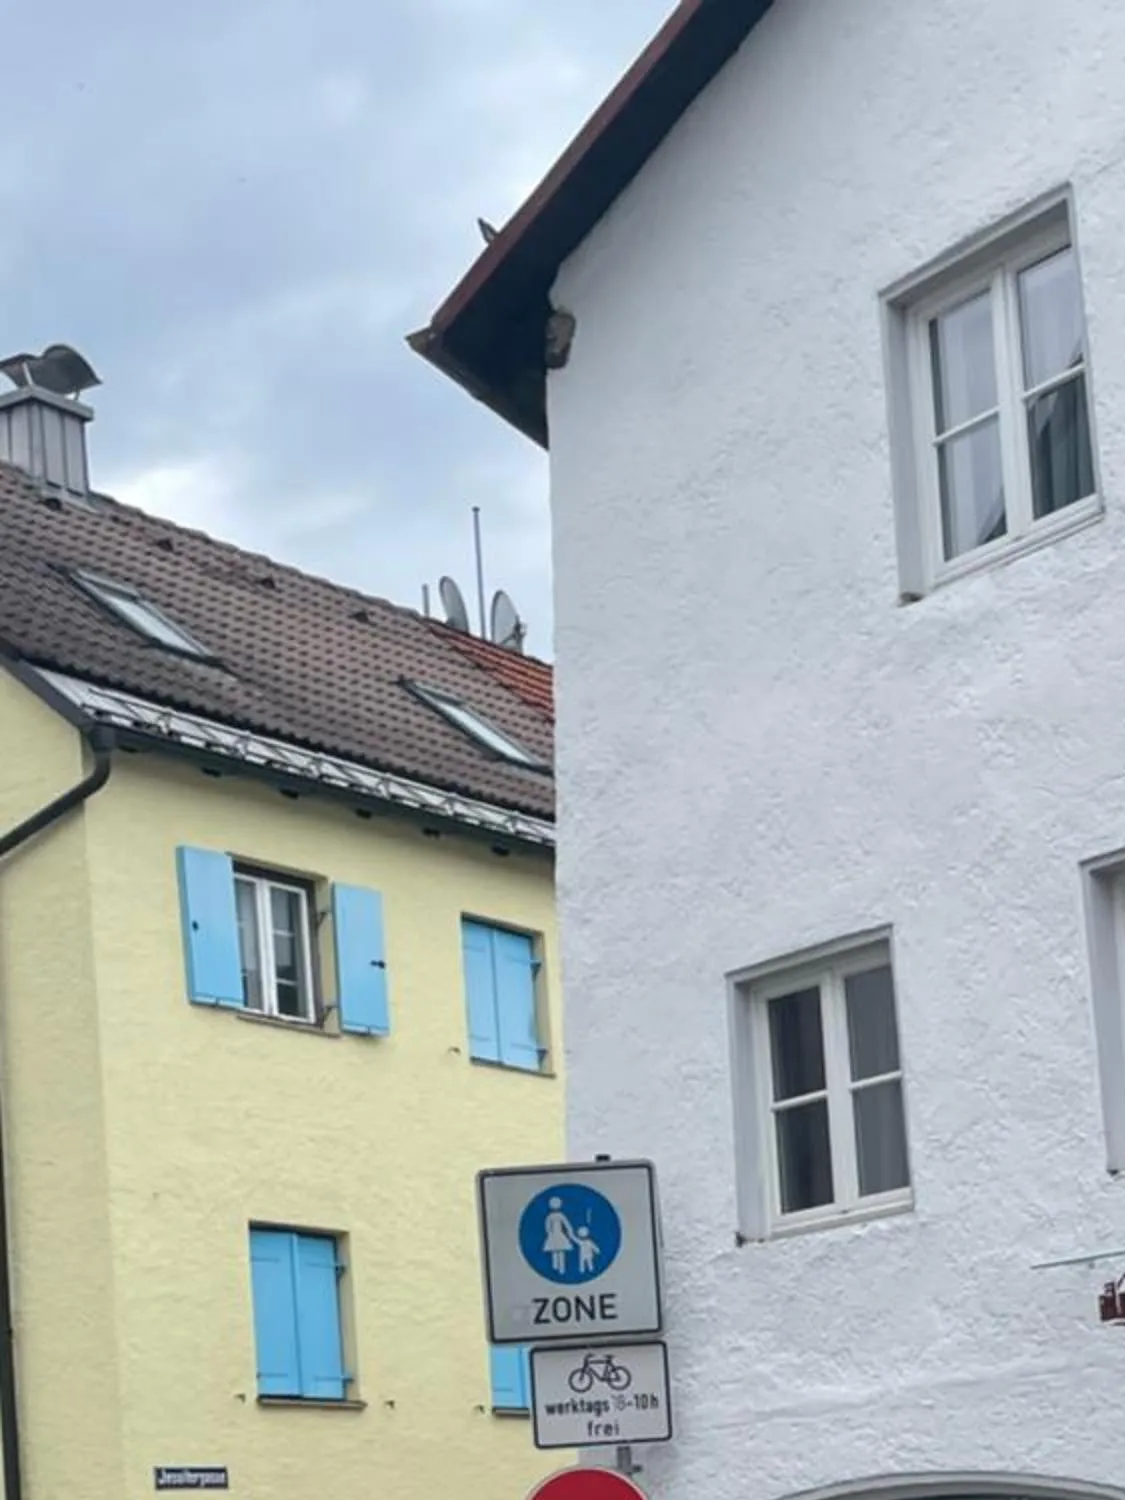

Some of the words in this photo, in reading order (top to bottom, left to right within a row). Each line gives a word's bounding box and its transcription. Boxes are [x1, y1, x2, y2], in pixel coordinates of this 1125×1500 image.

[532, 1293, 618, 1325] ZONE
[544, 1397, 610, 1417] werktags
[587, 1419, 620, 1437] frei
